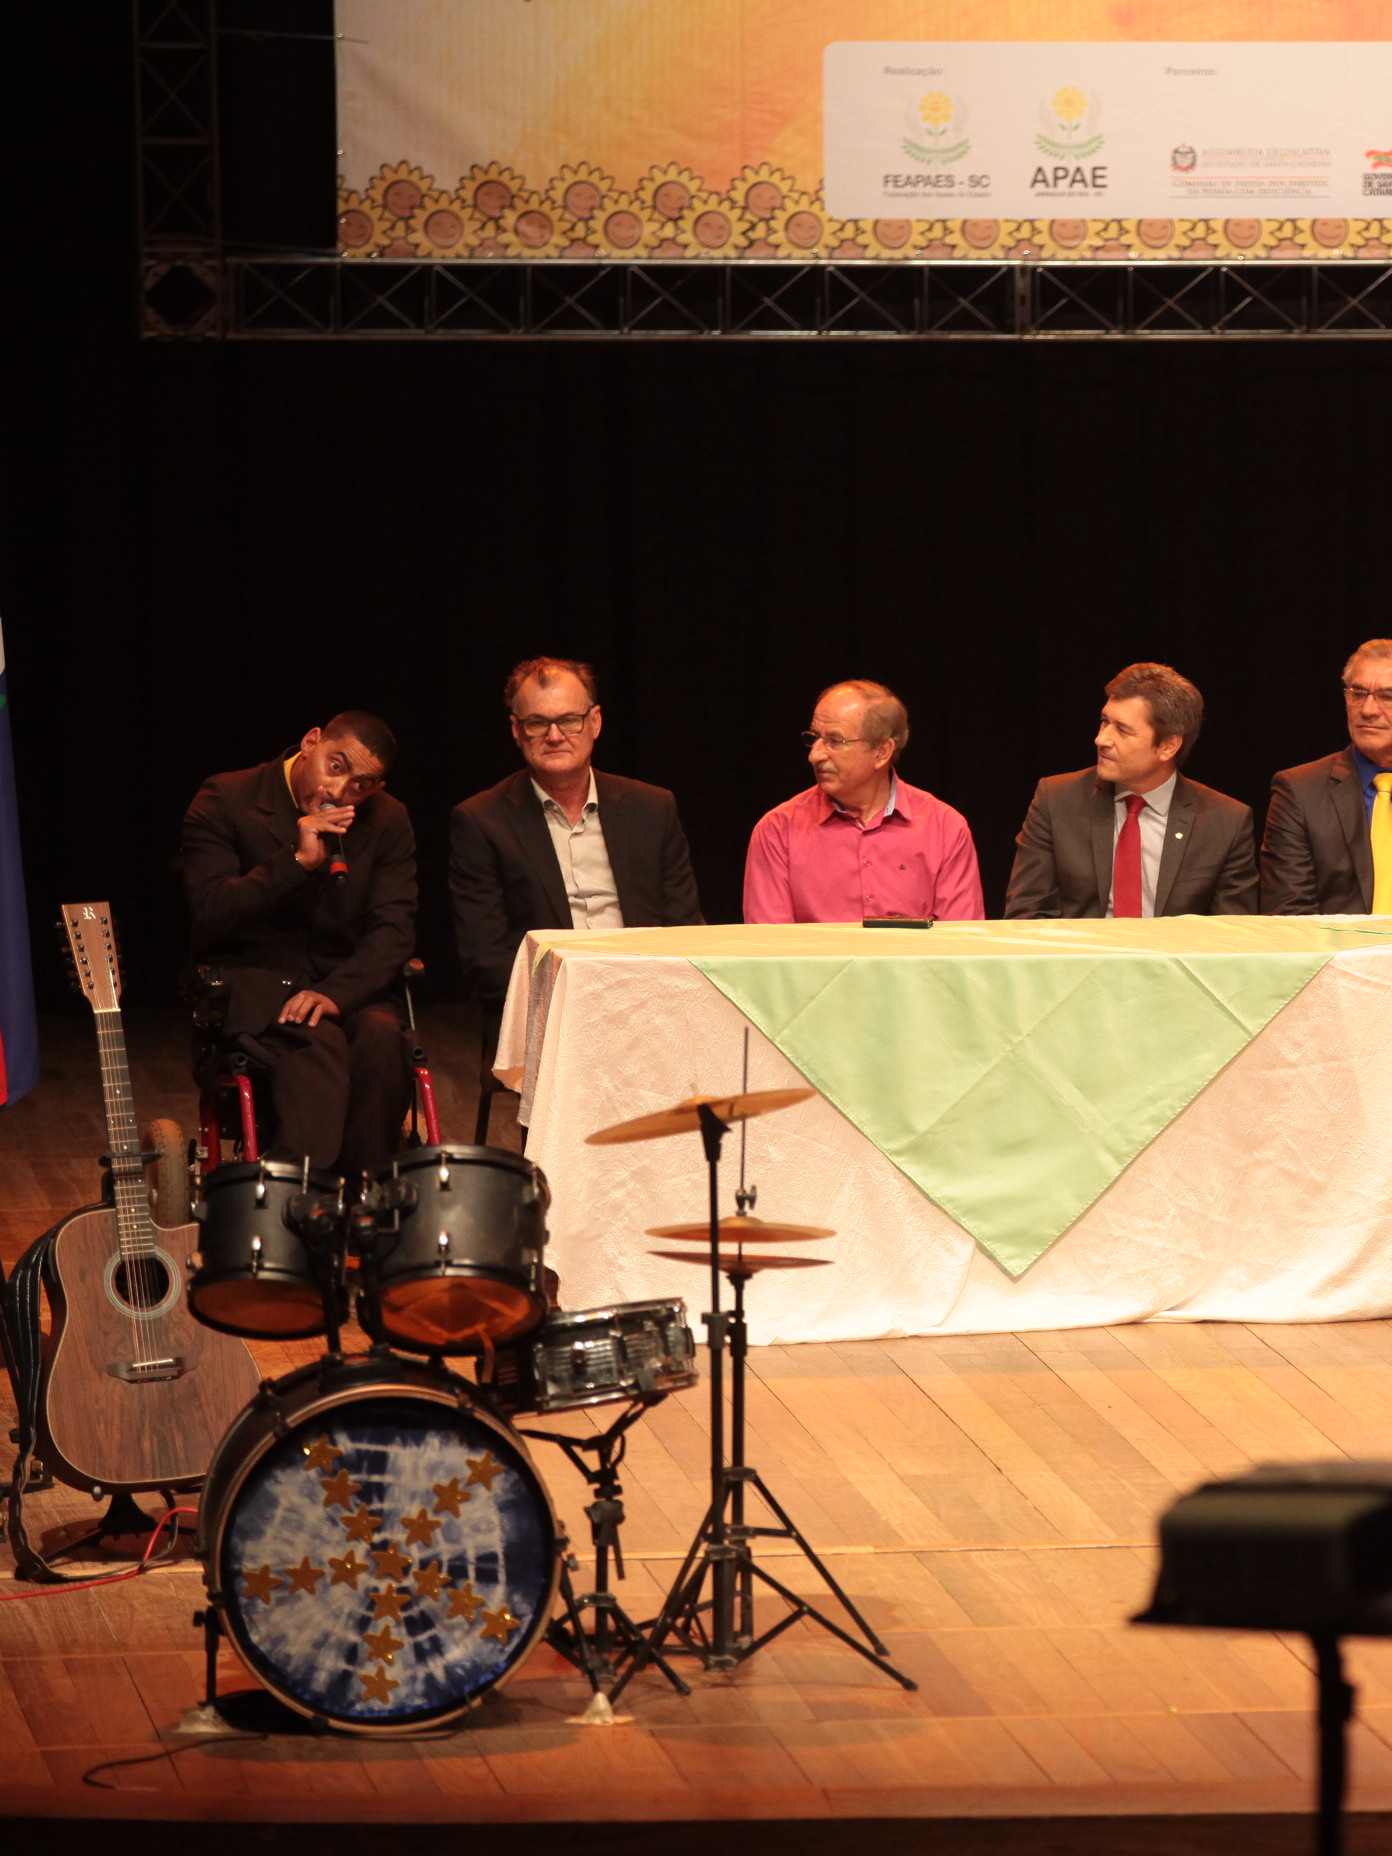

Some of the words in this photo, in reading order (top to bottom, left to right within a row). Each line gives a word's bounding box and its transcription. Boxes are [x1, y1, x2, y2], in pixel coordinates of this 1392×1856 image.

[882, 174, 955, 189] FEAPAES
[966, 174, 991, 189] SC
[1030, 165, 1108, 189] APAE
